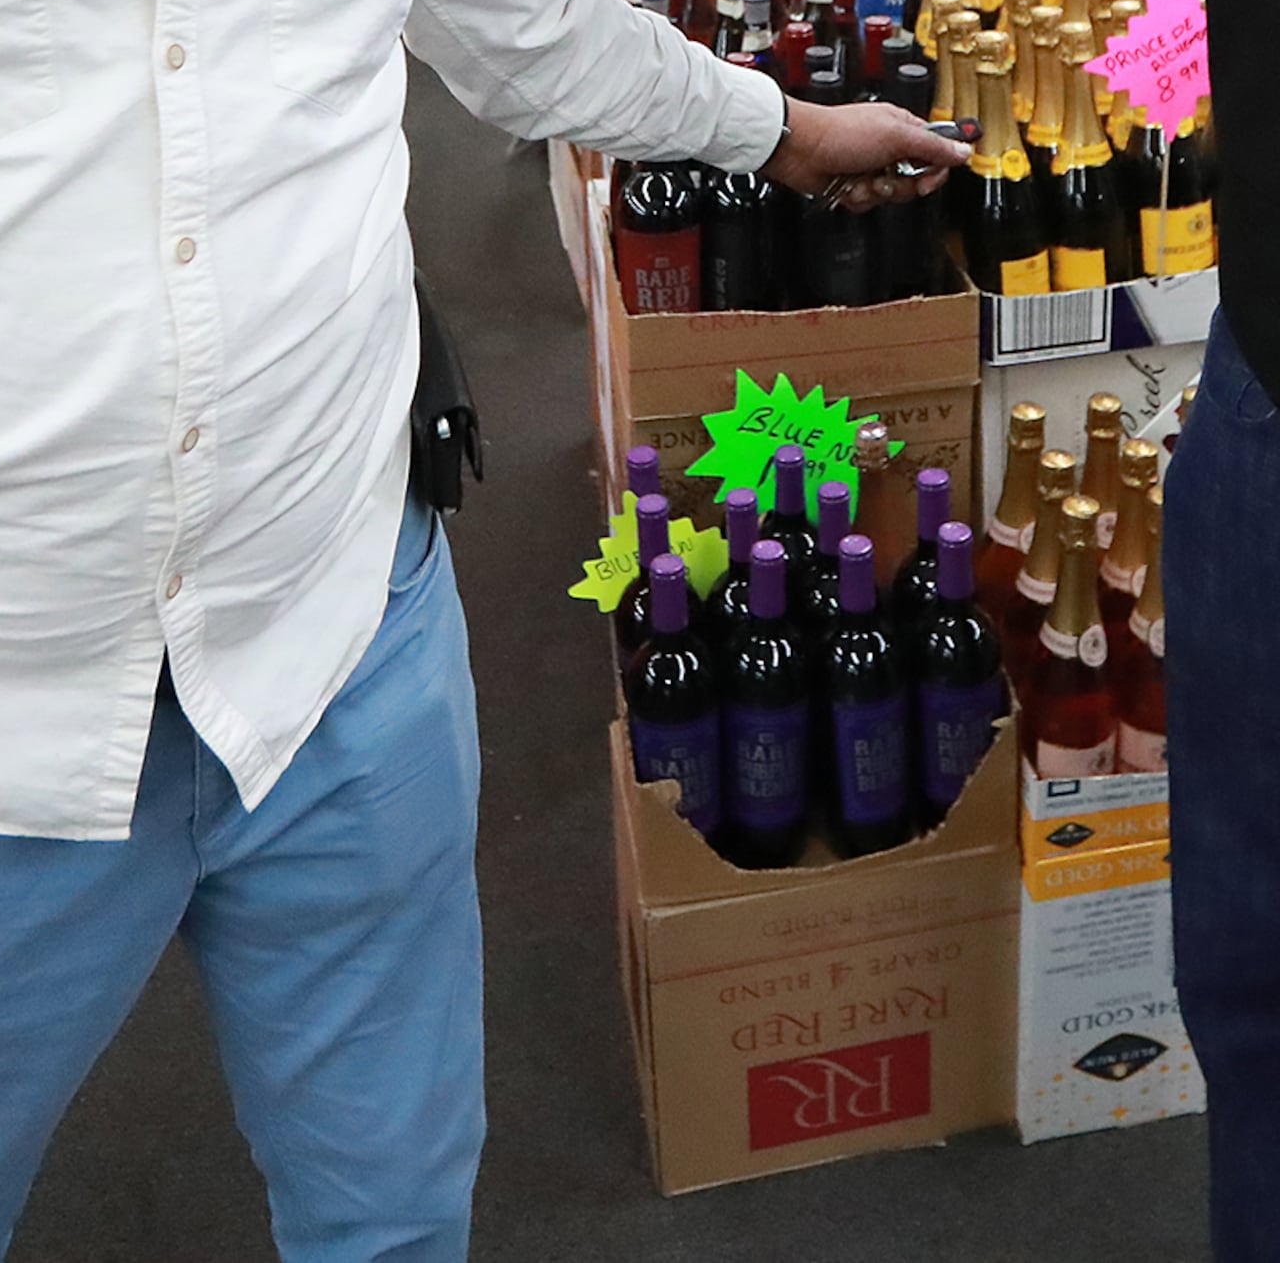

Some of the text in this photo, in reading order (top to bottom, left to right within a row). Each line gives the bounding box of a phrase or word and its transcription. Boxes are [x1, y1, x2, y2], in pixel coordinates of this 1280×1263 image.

[1105, 17, 1193, 76] PRINCE DE
[1157, 60, 1199, 104] 8 99
[634, 266, 692, 287] RARE
[736, 406, 824, 449] BLUE
[719, 942, 961, 1005] GRAPE 4 BLEND
[731, 986, 950, 1052] RARE RED
[1061, 1007, 1134, 1034] GOLD
[768, 1054, 894, 1129] RR
